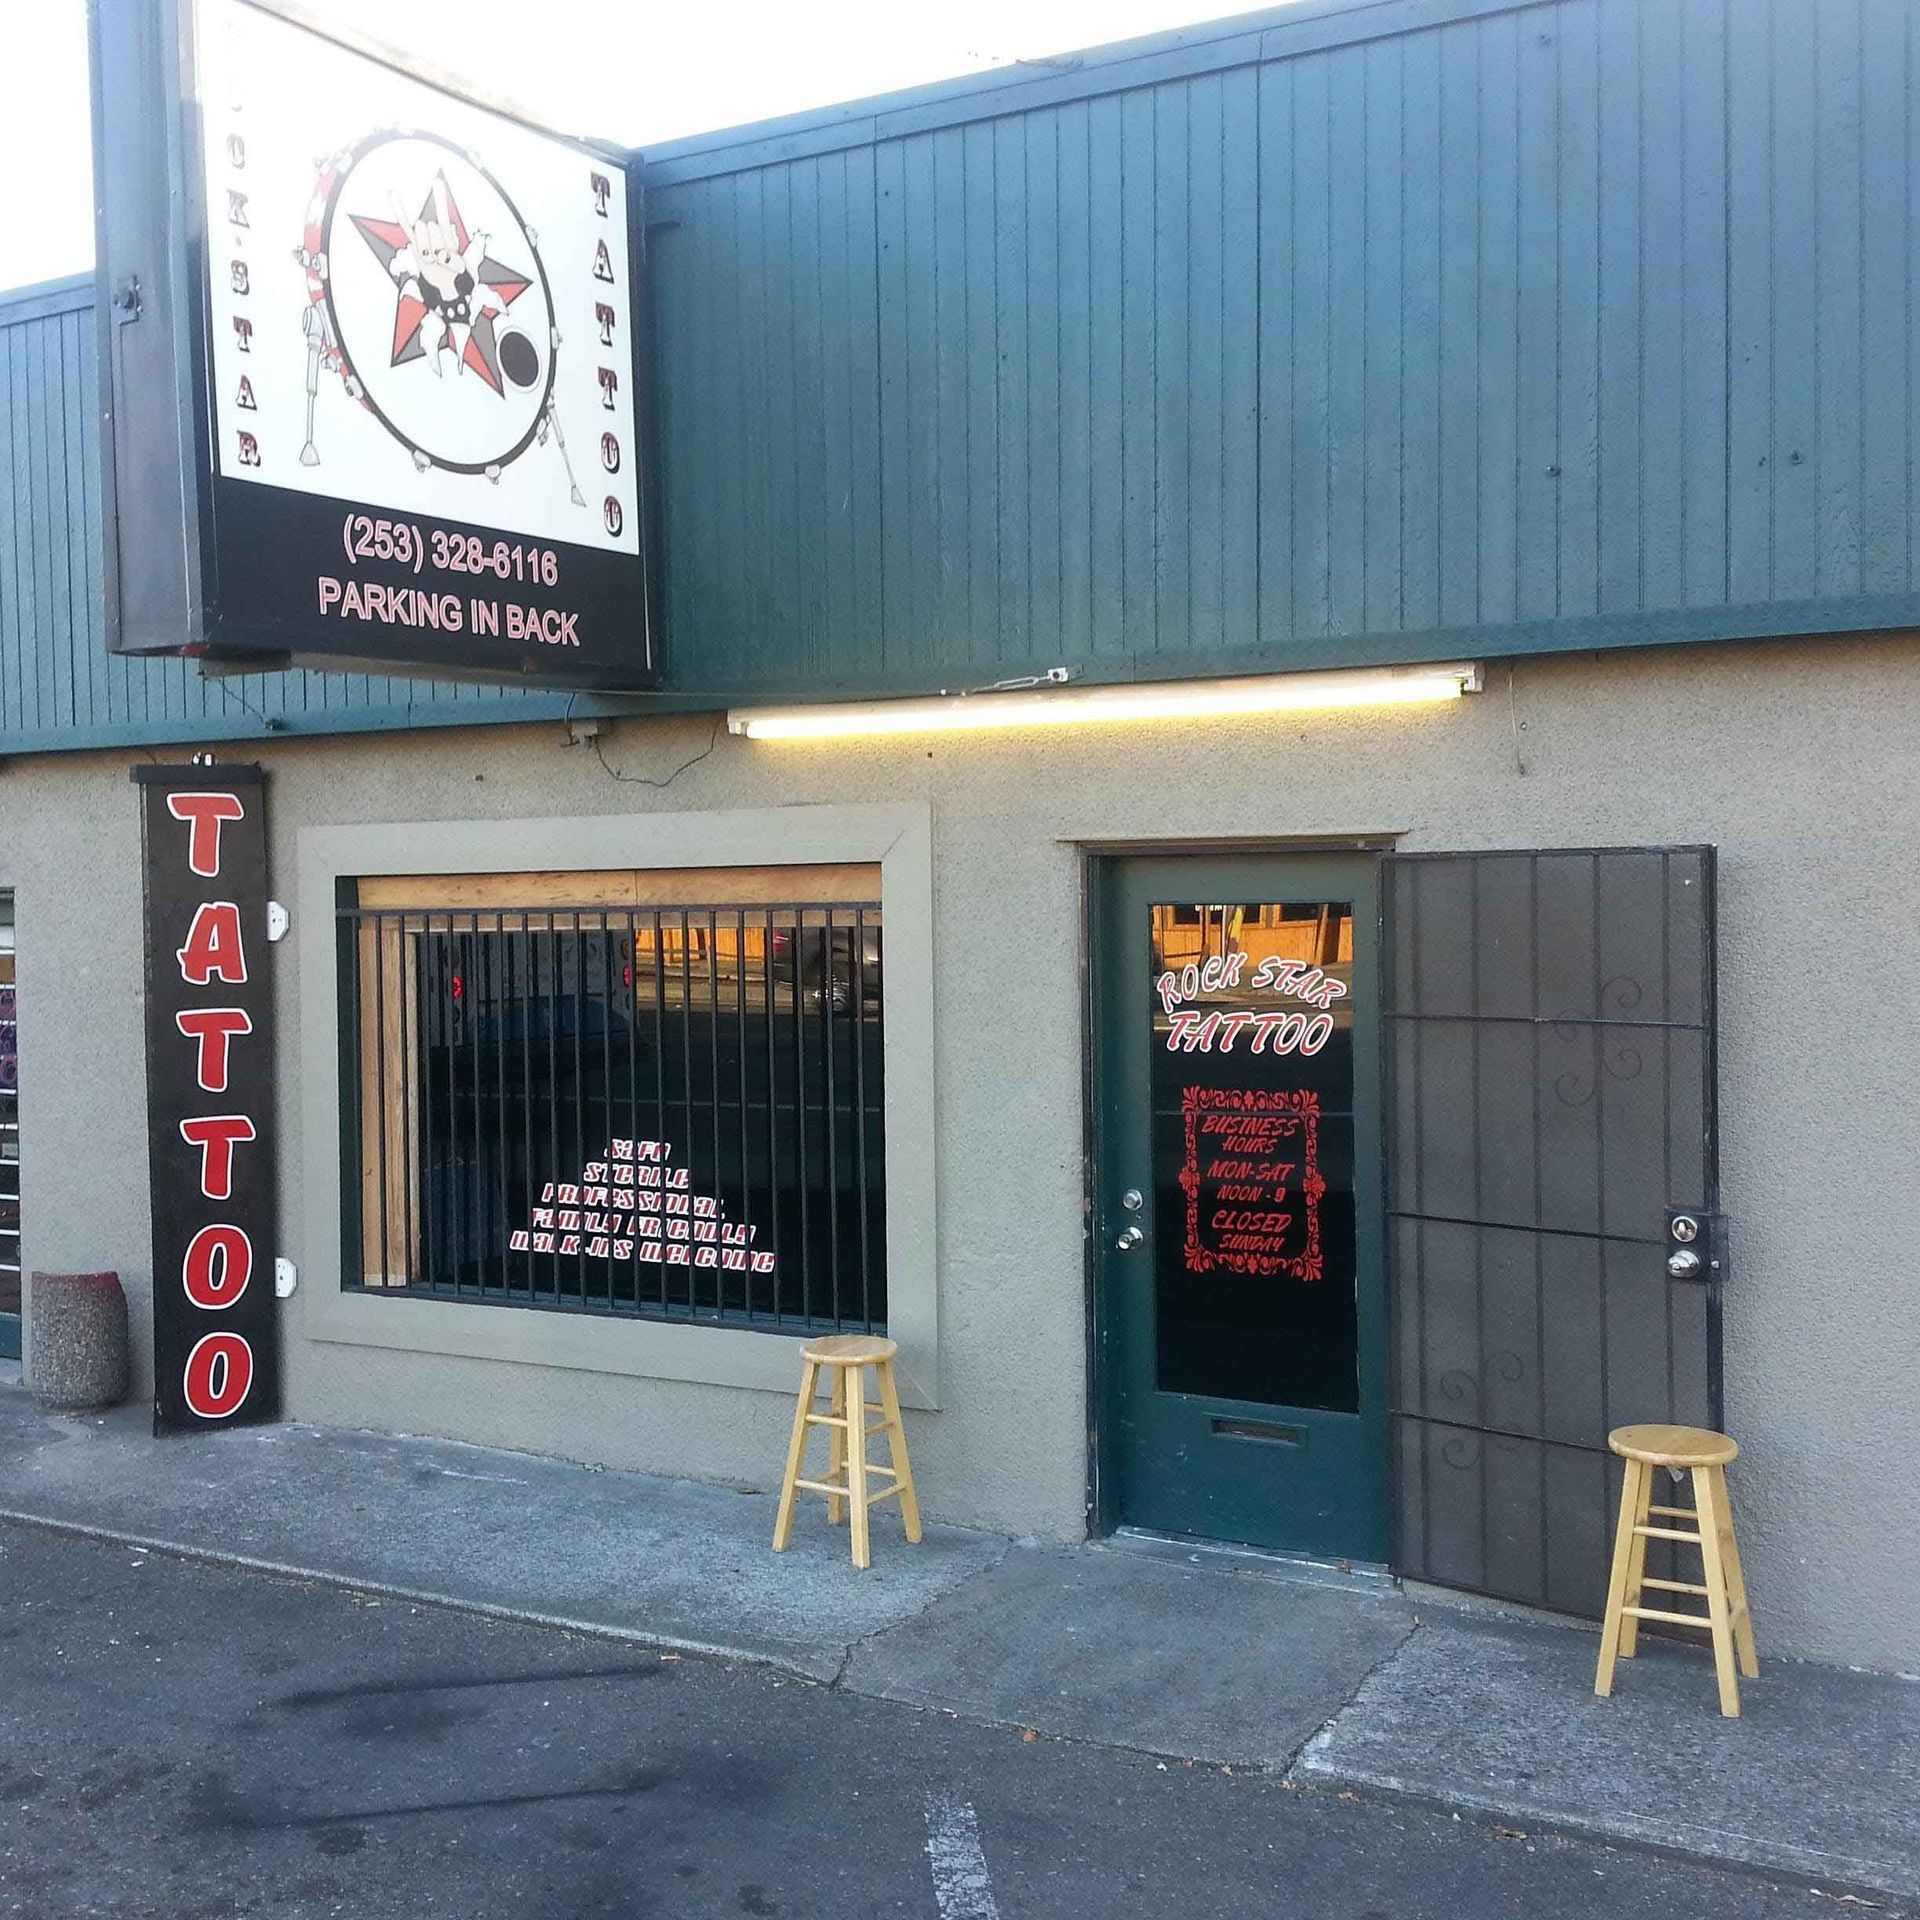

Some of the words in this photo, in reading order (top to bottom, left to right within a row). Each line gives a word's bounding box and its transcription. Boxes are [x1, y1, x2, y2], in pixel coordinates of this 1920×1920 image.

[590, 171, 622, 537] TATTOO
[344, 514, 423, 573] (253)
[431, 530, 558, 586] 328-6116
[318, 576, 462, 631] PARKING
[471, 599, 498, 636] IN
[506, 604, 580, 646] BACK
[1157, 952, 1248, 1013] ROCK
[1252, 955, 1347, 1009] STAR
[1167, 1011, 1334, 1056] TATTOO
[166, 793, 256, 1418] TATTOO
[1201, 1115, 1299, 1136] BUSINESS
[1222, 1135, 1278, 1154] HOURS
[583, 1162, 690, 1188] STERILE
[1207, 1160, 1296, 1181] MON-SAT
[1217, 1184, 1263, 1202] NOON
[1274, 1187, 1286, 1203] 9
[531, 1208, 623, 1234] FAMILY
[1212, 1210, 1292, 1232] CLOSED
[1219, 1234, 1285, 1251] SUNDAY
[639, 1241, 775, 1273] WELCOME
